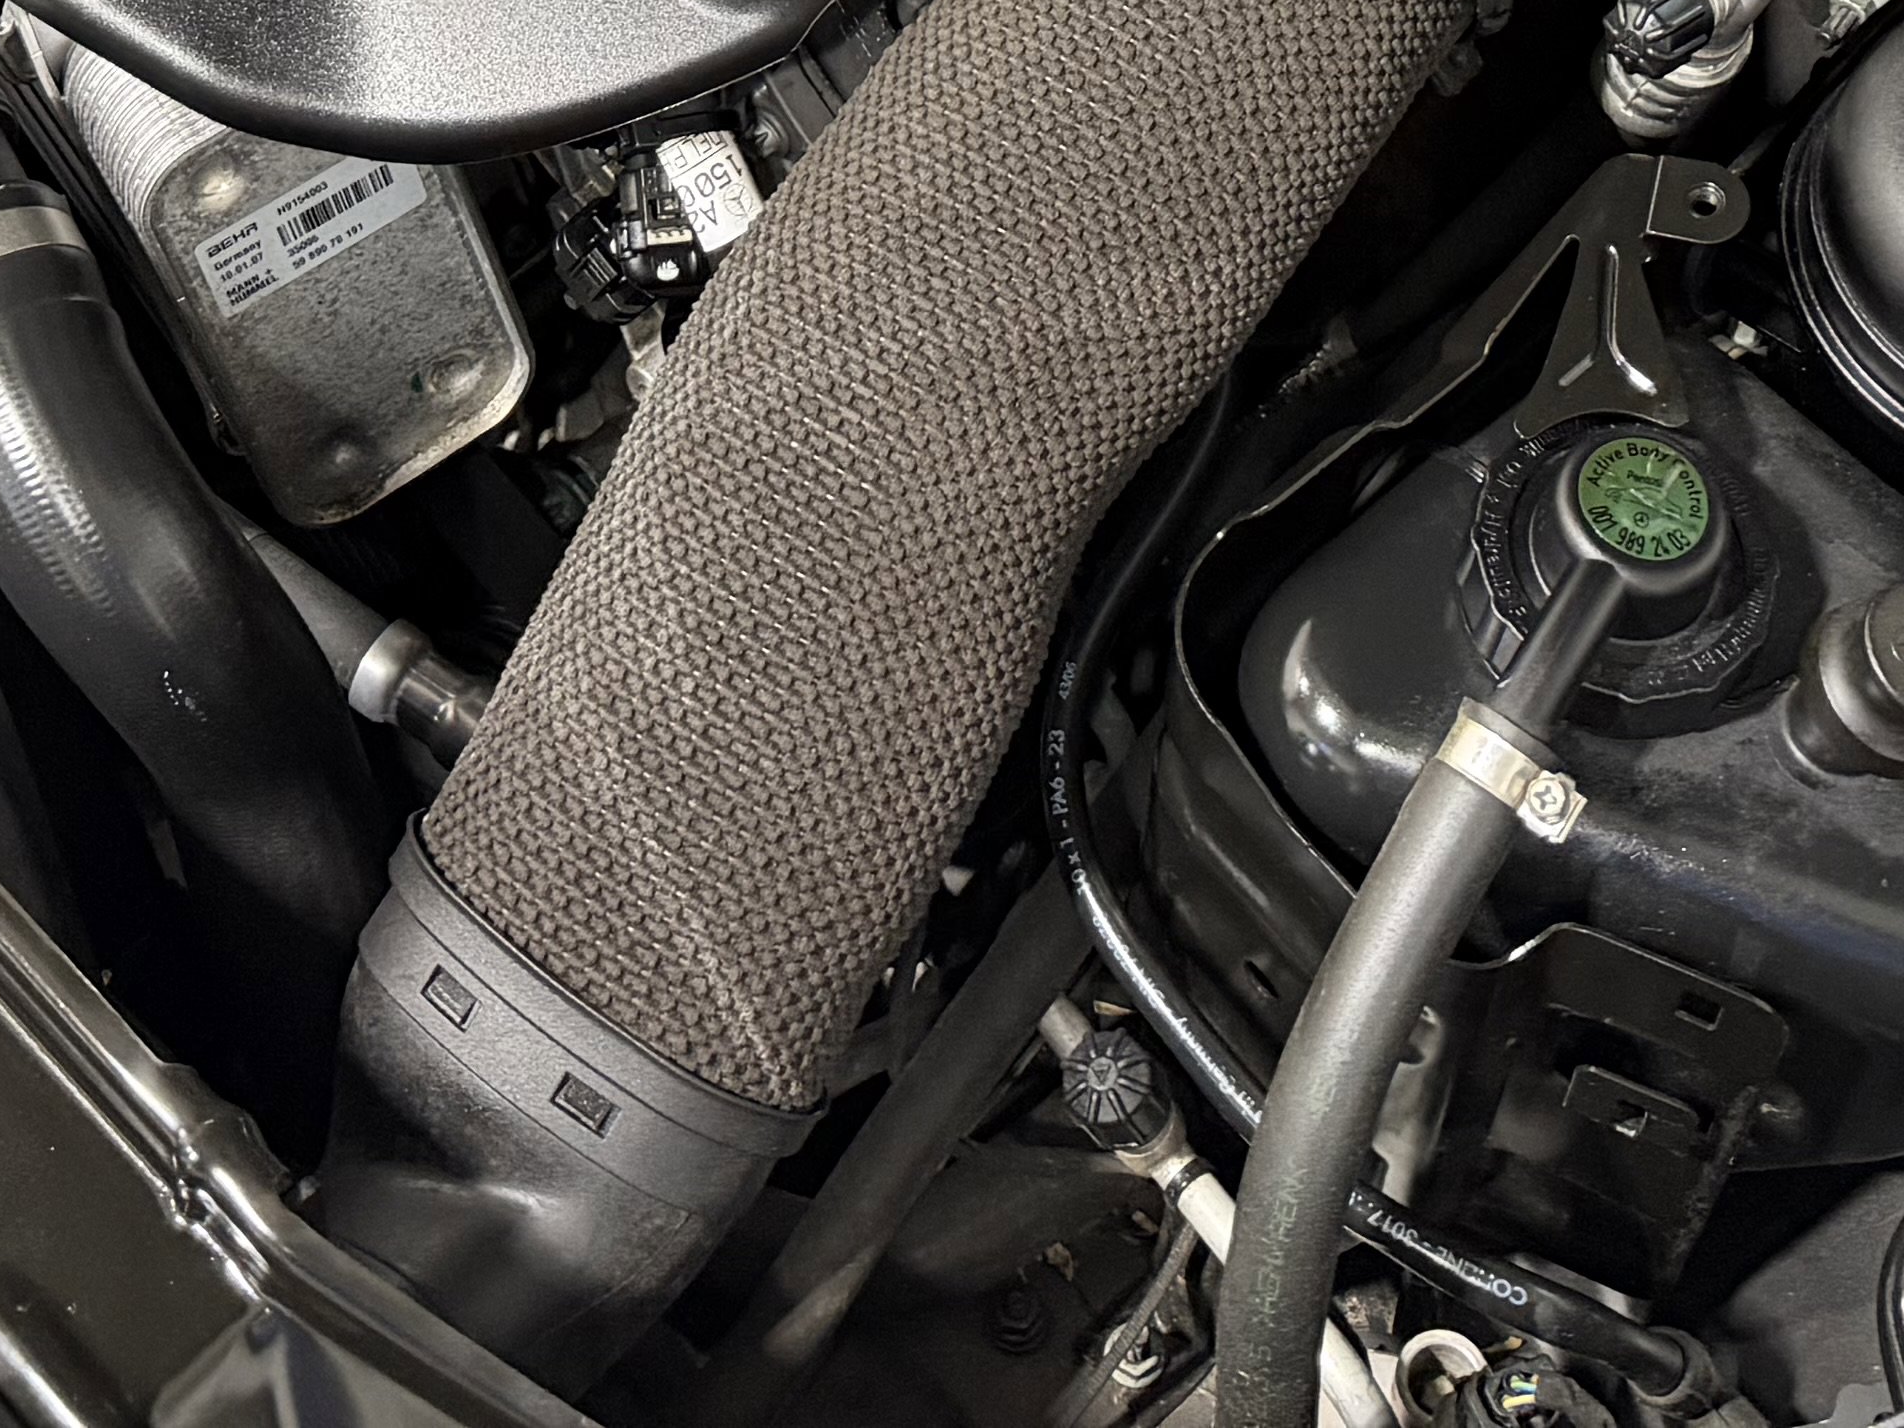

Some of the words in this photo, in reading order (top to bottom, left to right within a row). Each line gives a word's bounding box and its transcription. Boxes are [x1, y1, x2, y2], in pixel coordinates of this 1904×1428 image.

[203, 220, 260, 259] BEHR
[212, 237, 264, 273] Germany
[224, 272, 261, 299] MANN
[1586, 448, 1624, 487] Active
[1626, 442, 1670, 463] Body
[1617, 530, 1646, 555] 989
[1669, 529, 1692, 552] 03
[1046, 727, 1066, 755] 23
[1049, 776, 1068, 814] PA6
